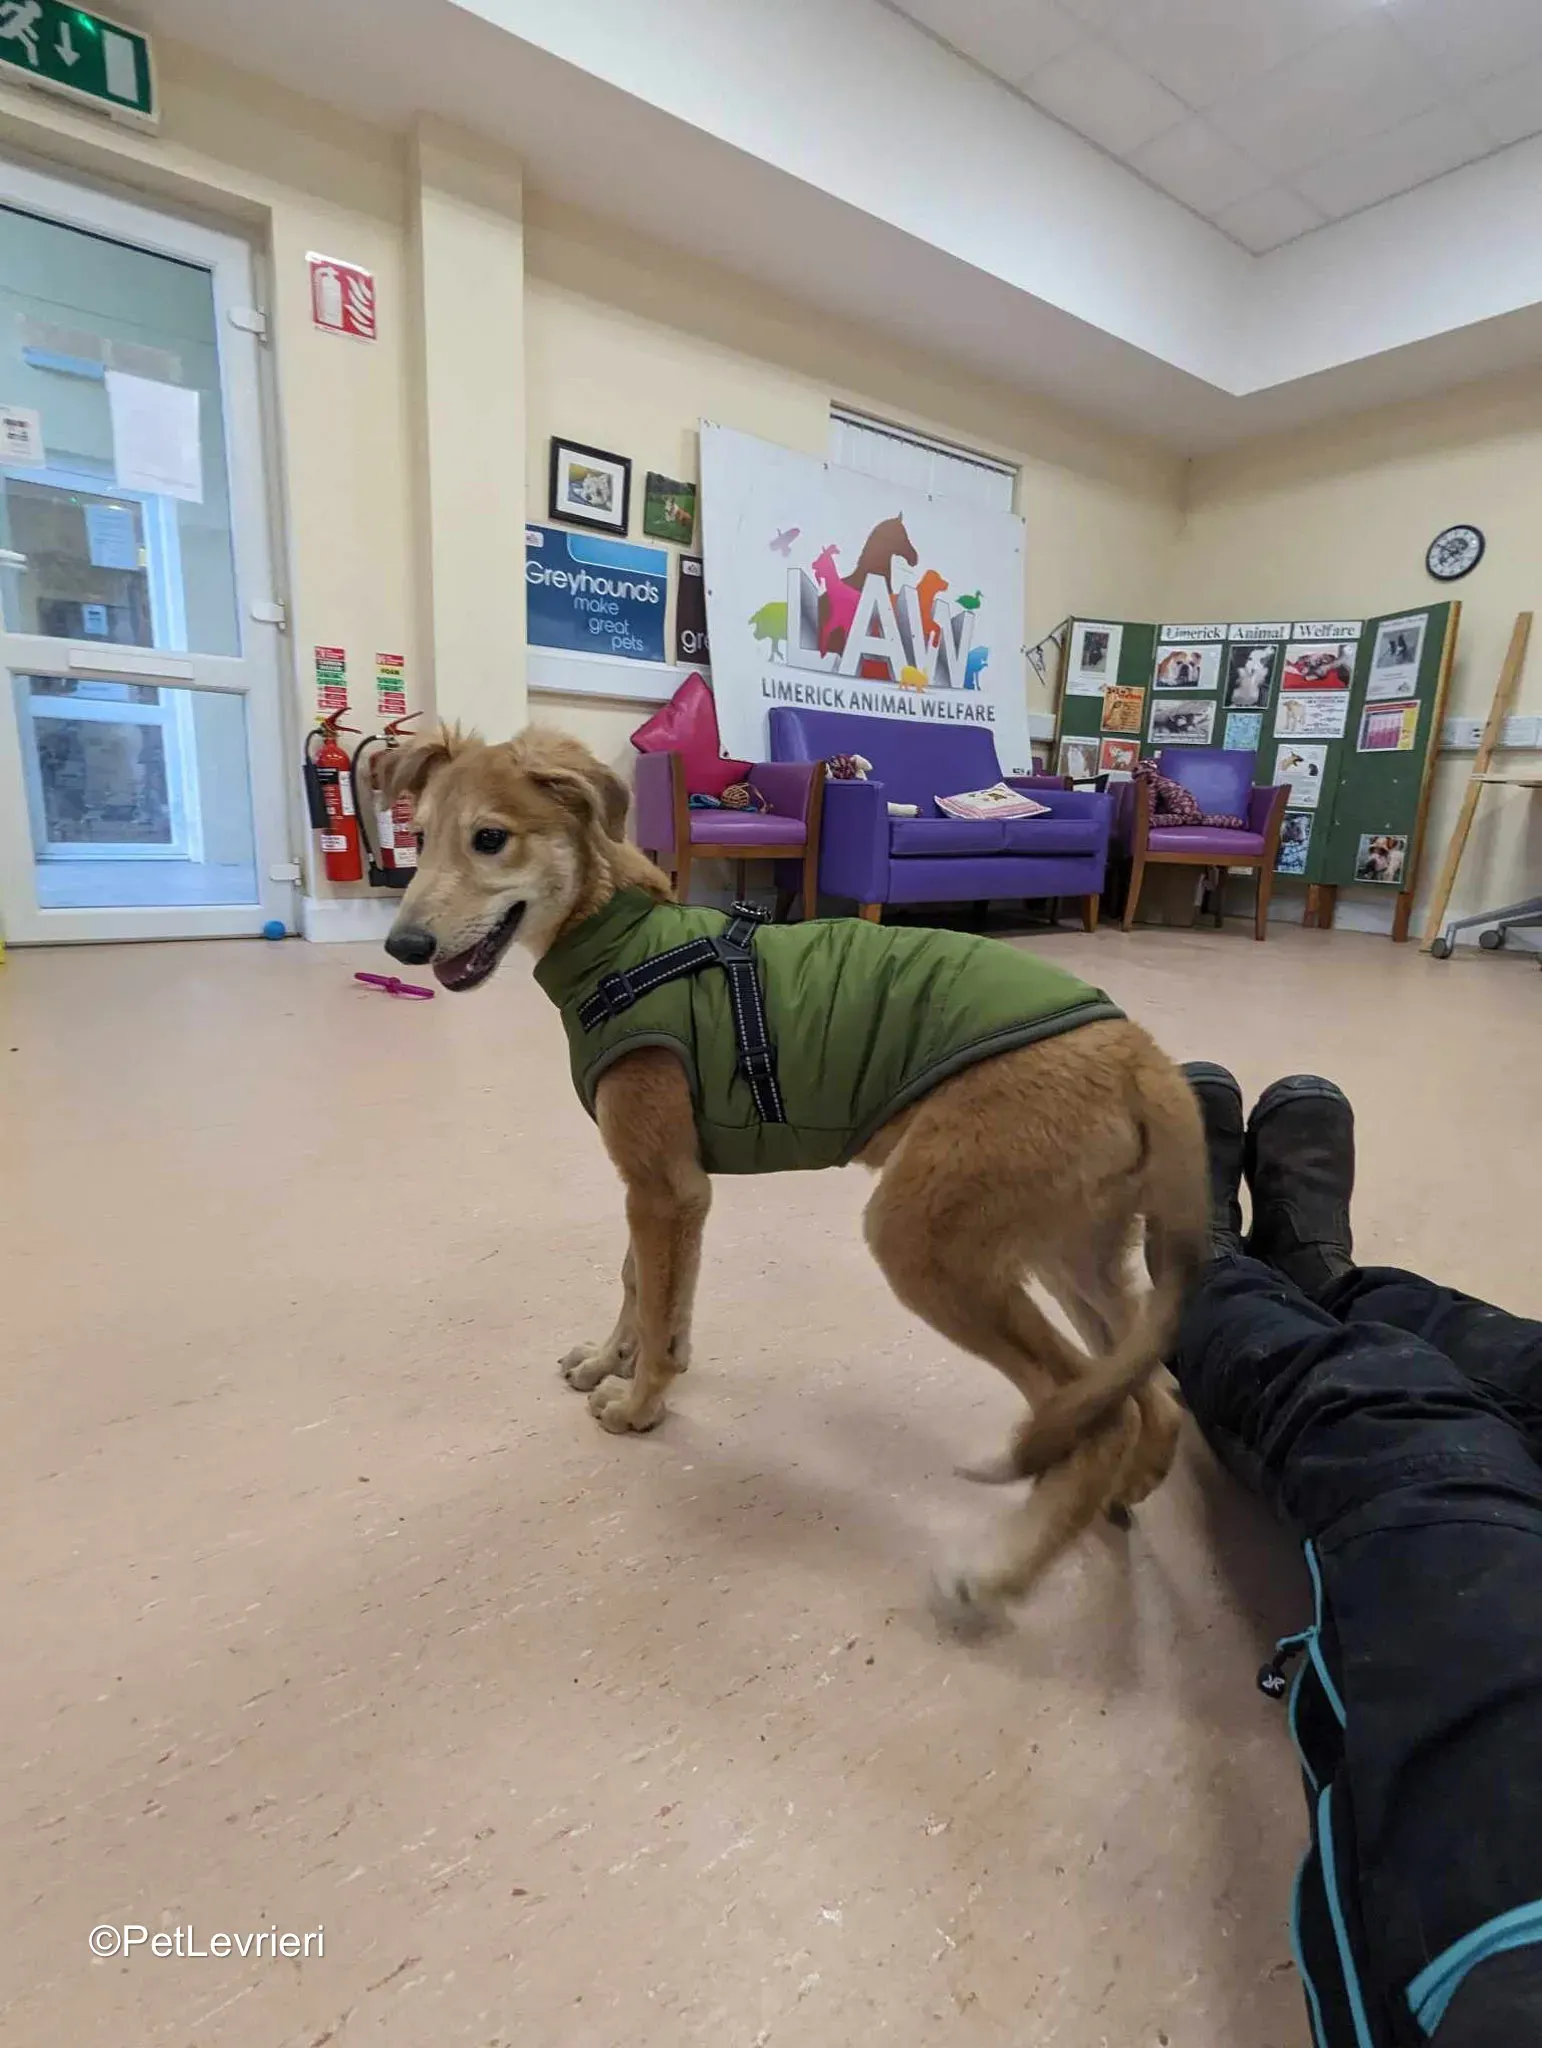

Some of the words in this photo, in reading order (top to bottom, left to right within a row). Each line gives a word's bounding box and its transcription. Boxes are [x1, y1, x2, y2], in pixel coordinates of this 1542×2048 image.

[525, 560, 660, 604] Greyhounds
[574, 596, 620, 616] make
[588, 617, 631, 636] great
[786, 567, 976, 689] LAW
[1166, 626, 1222, 640] Limerick
[1232, 625, 1285, 640] Animal
[1299, 623, 1356, 638] Welfare
[611, 634, 645, 652] pets
[761, 677, 845, 709] LIMERICK
[849, 691, 917, 717] ANIMAL
[921, 699, 996, 722] WELFARE
